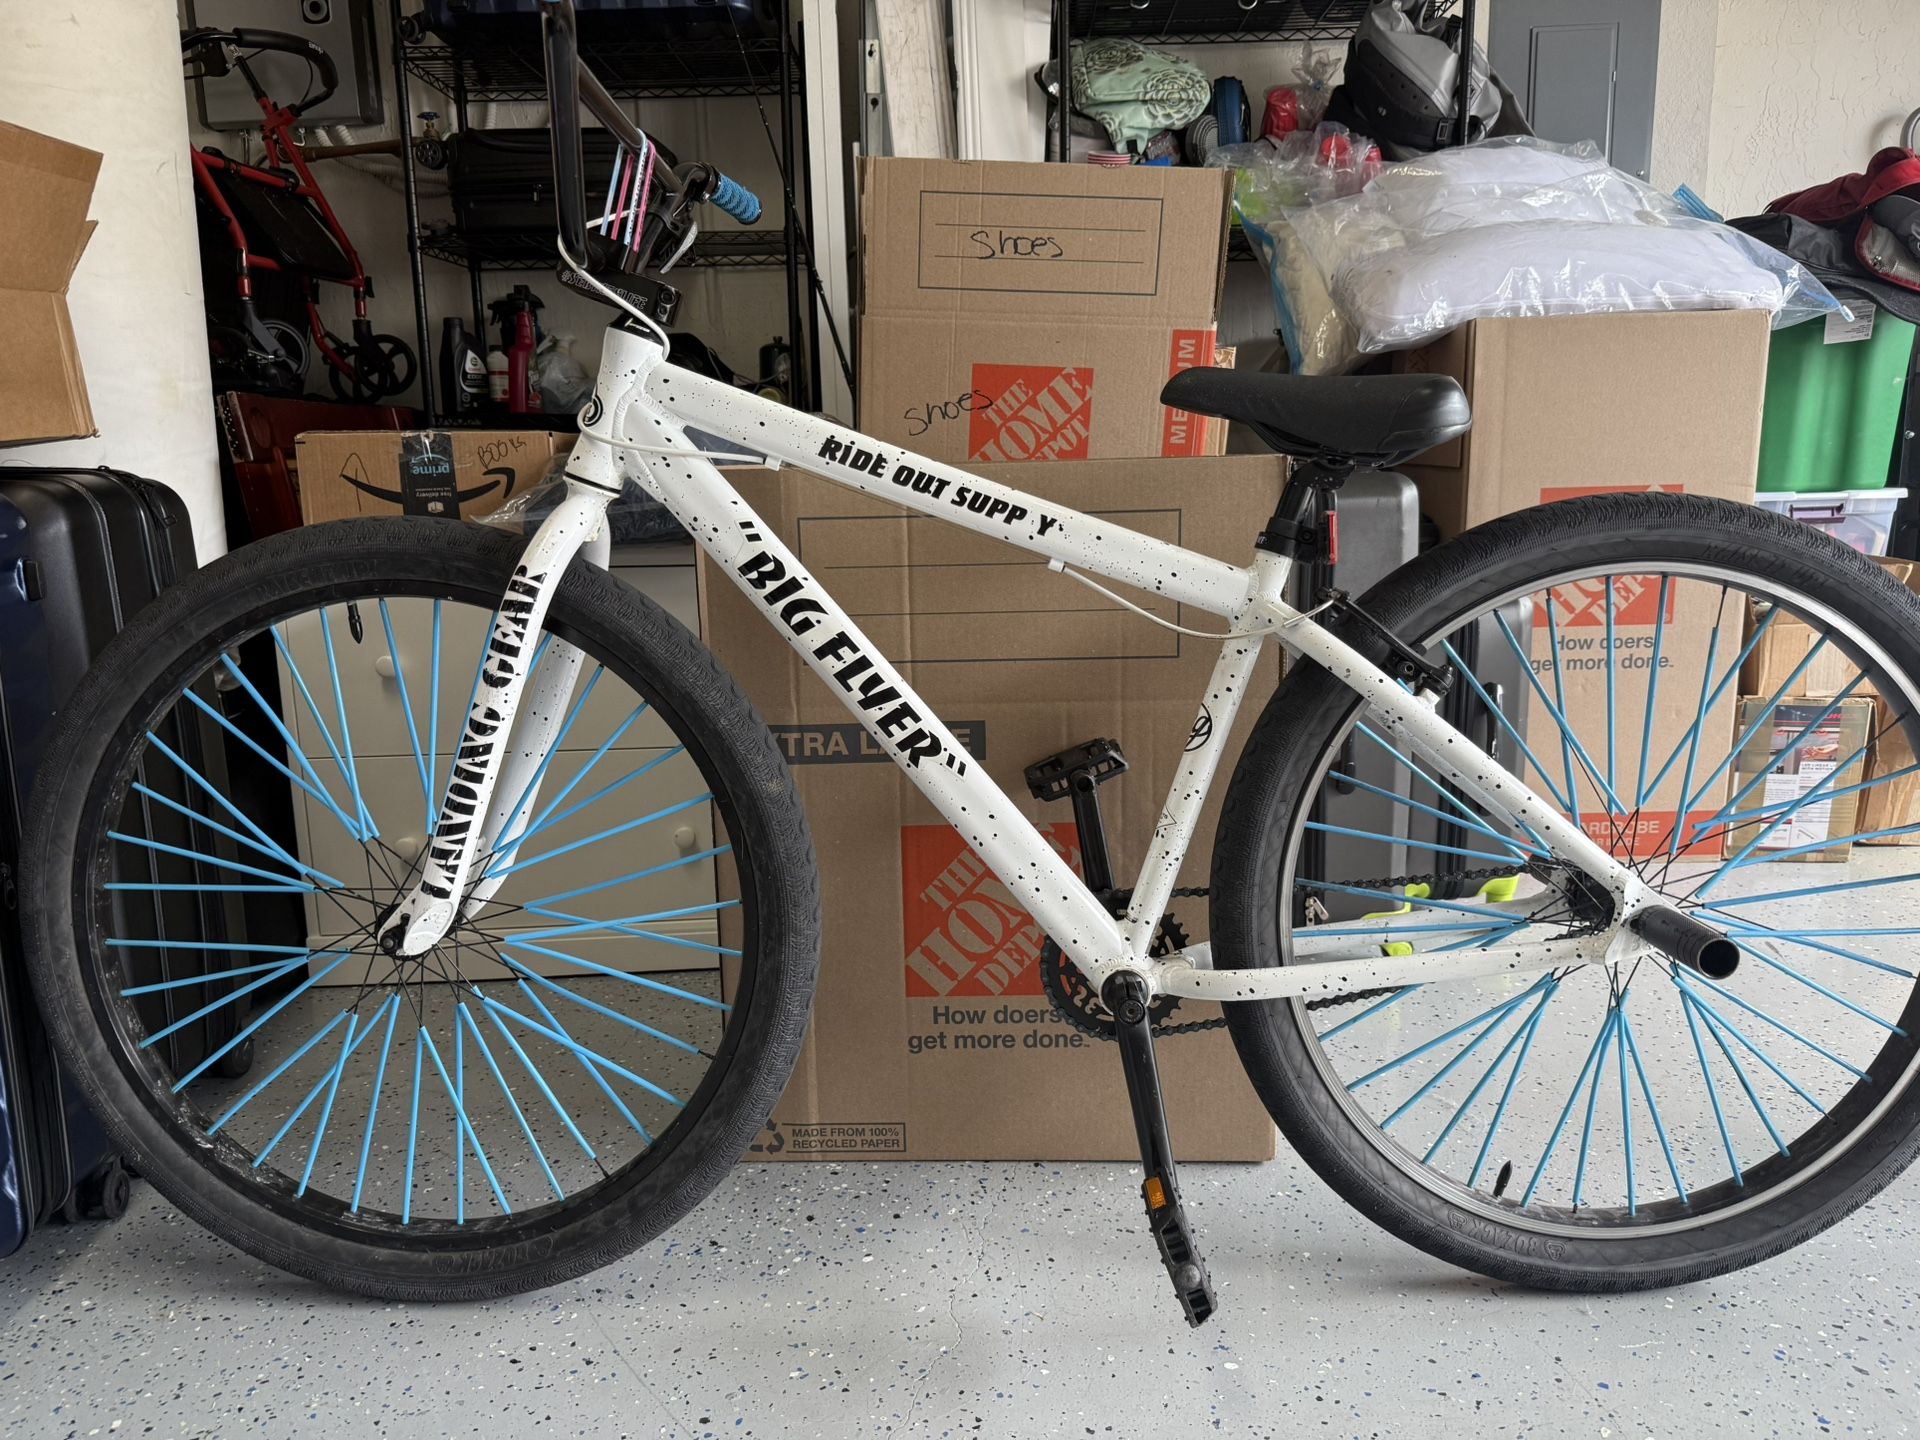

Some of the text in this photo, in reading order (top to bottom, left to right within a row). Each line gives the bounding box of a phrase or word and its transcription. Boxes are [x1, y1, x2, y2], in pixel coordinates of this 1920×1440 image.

[982, 378, 1033, 429] THE
[412, 462, 450, 477] prime
[892, 464, 951, 499] OUT
[420, 565, 547, 899] LANDING GEAR
[933, 1005, 1062, 1024] How doers
[908, 1031, 947, 1054] get
[954, 1033, 1016, 1049] more
[792, 1127, 899, 1138] MADE FROM 100%
[793, 1138, 900, 1149] RECYCLED PAPER
